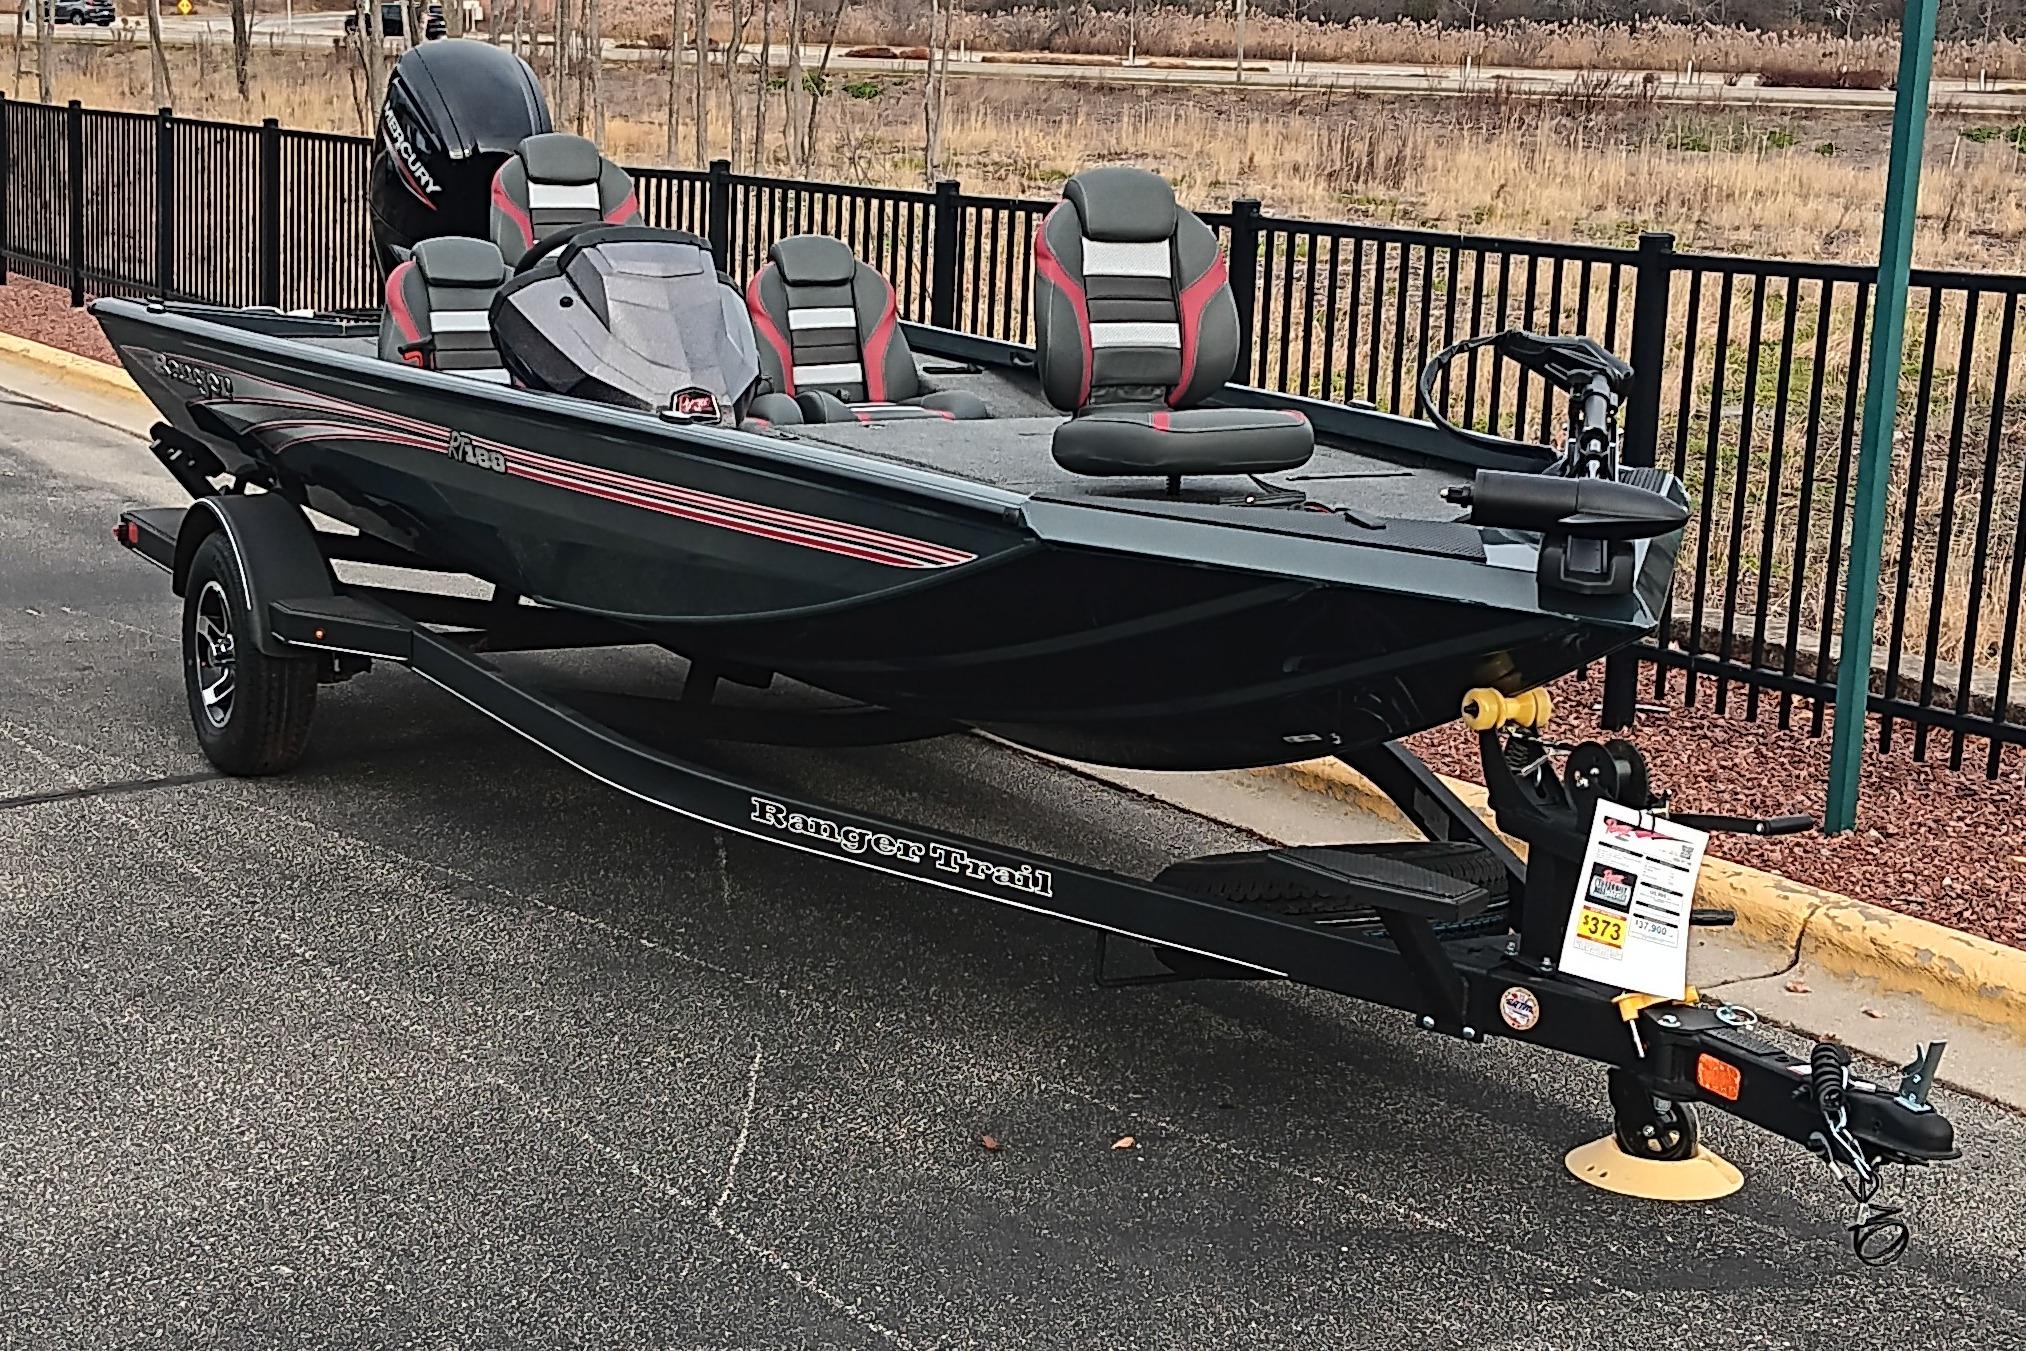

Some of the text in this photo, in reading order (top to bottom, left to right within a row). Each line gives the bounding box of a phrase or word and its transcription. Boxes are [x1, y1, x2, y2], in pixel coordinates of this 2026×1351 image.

[384, 100, 442, 193] MERCURY
[750, 796, 1053, 898] Ranger Trail
[1582, 914, 1622, 941] $373
